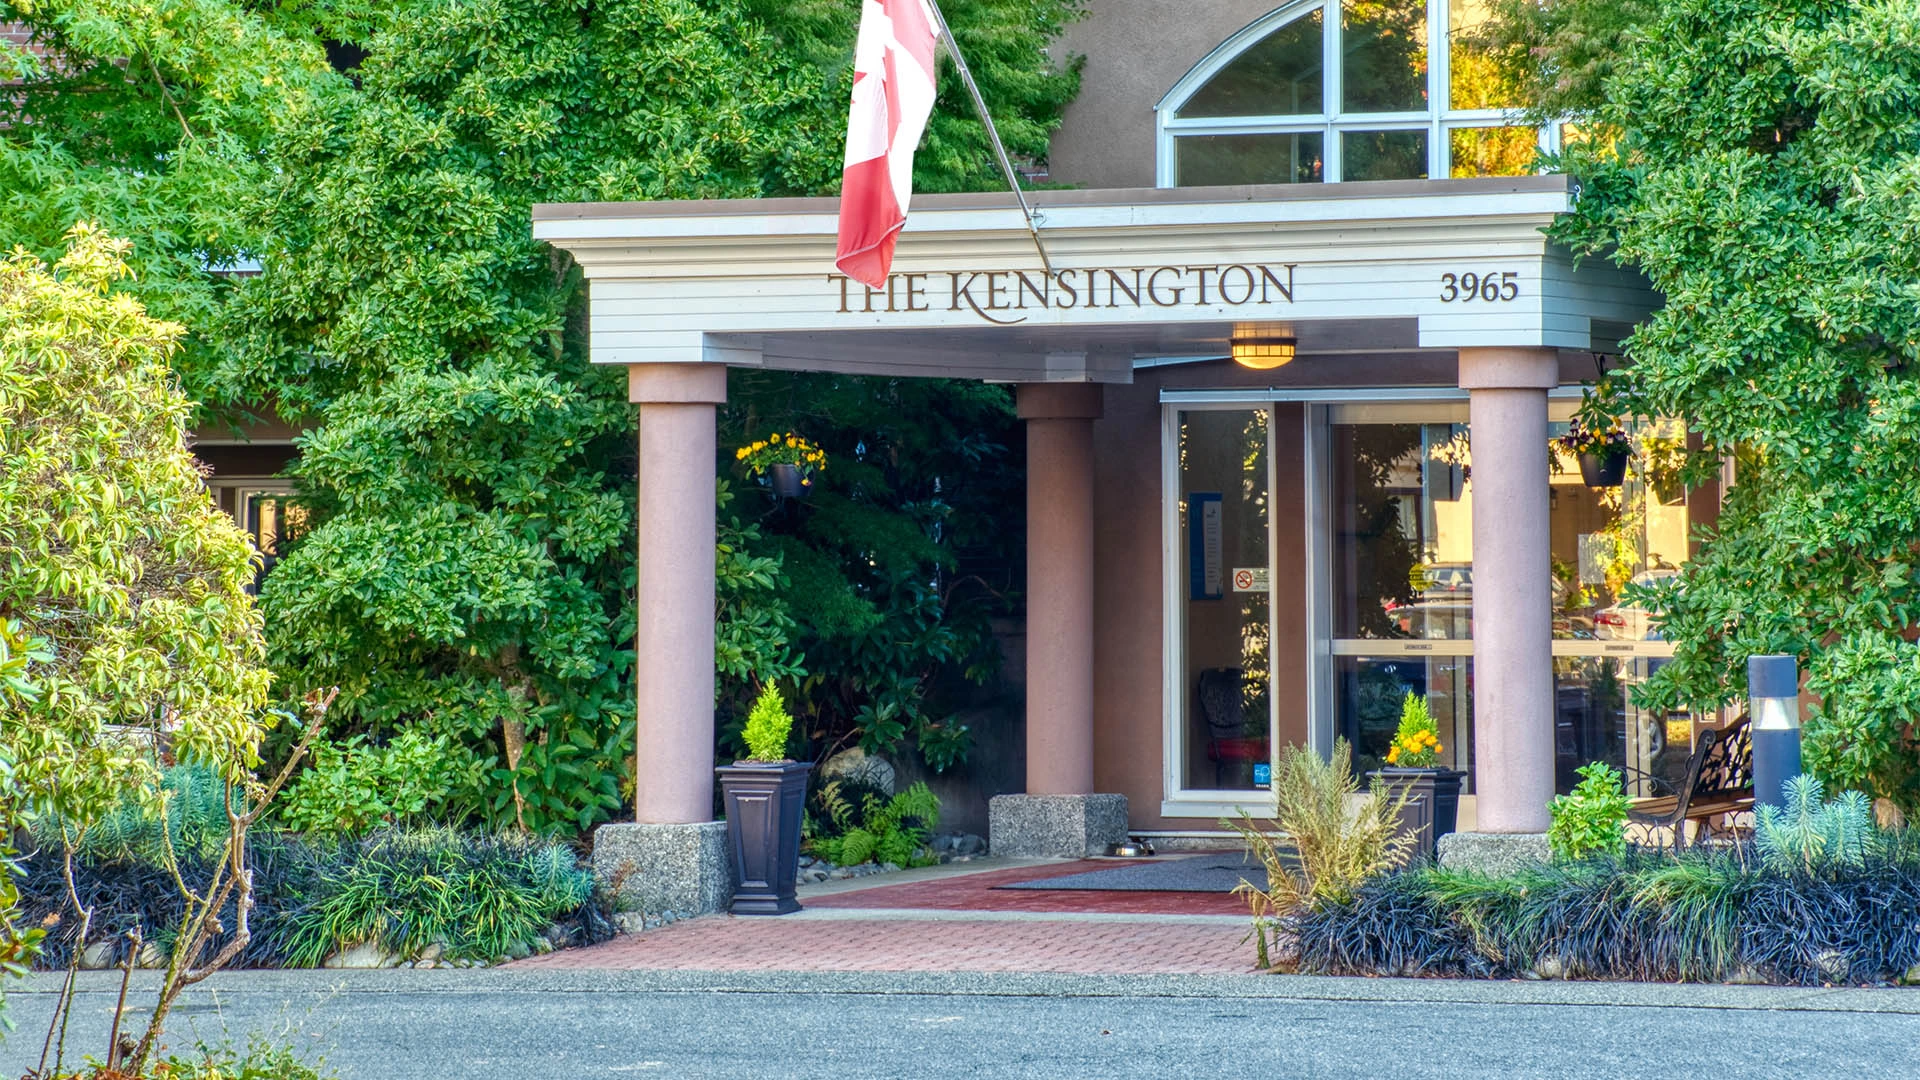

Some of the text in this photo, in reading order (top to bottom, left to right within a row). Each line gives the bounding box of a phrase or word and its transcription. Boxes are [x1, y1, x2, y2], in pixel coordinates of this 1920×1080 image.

[827, 264, 1297, 324] THE KENSINGTON
[1440, 272, 1519, 303] 3965
